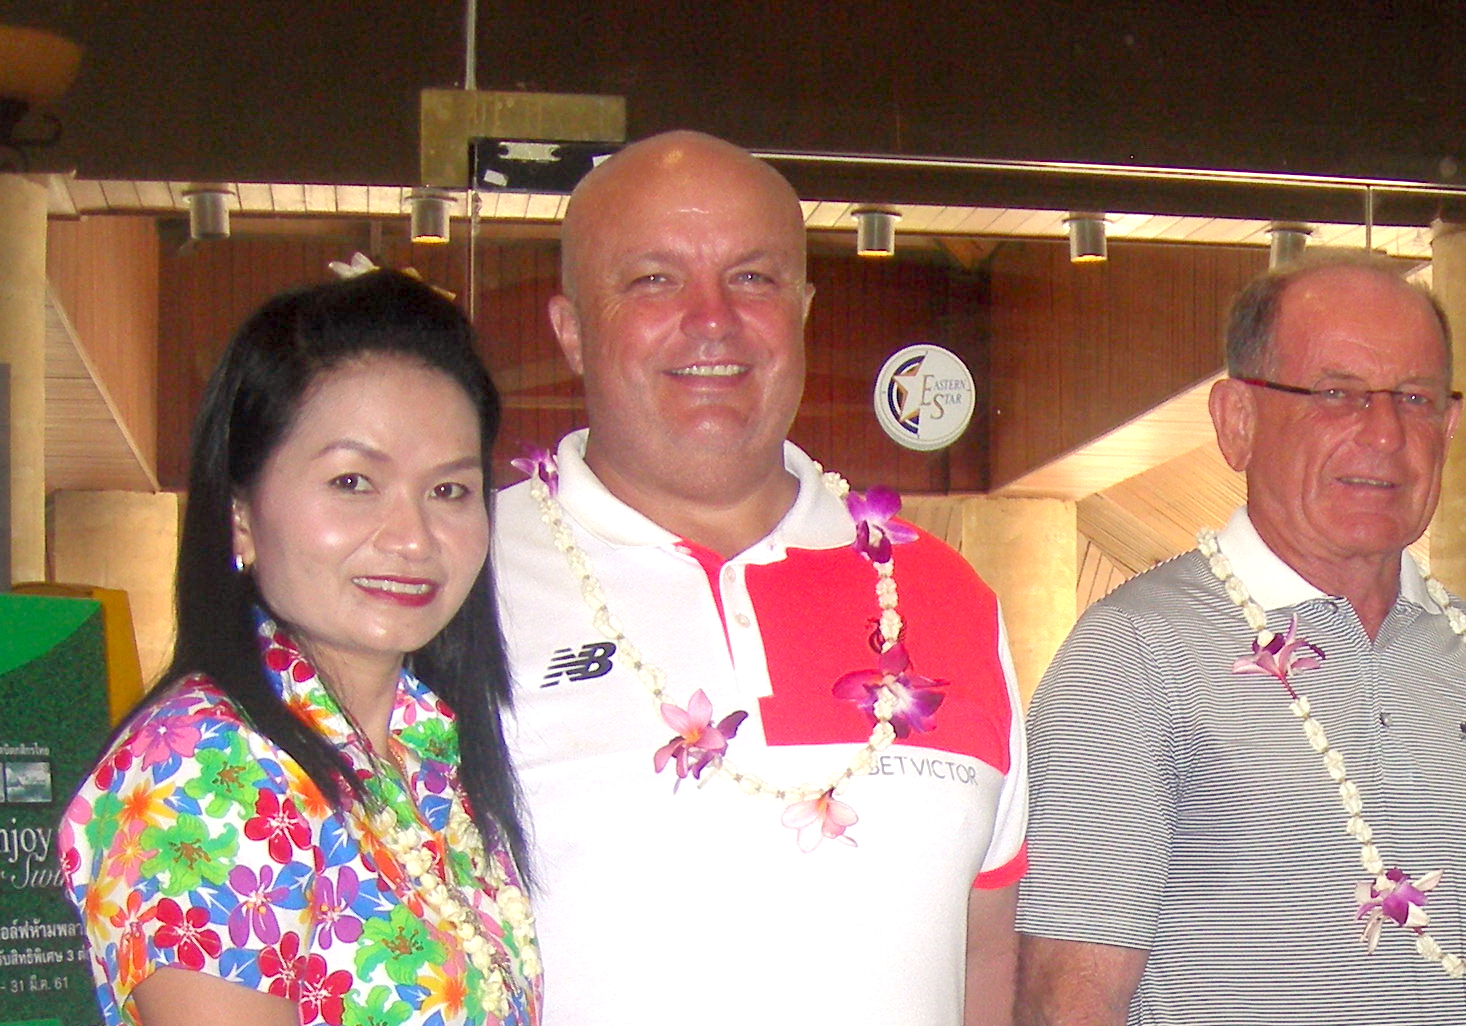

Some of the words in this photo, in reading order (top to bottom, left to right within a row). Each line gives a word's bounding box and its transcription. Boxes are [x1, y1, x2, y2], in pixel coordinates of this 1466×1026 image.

[930, 393, 962, 420] STAR
[66, 949, 75, 962] 3
[10, 979, 24, 993] 31
[54, 976, 68, 990] 61
